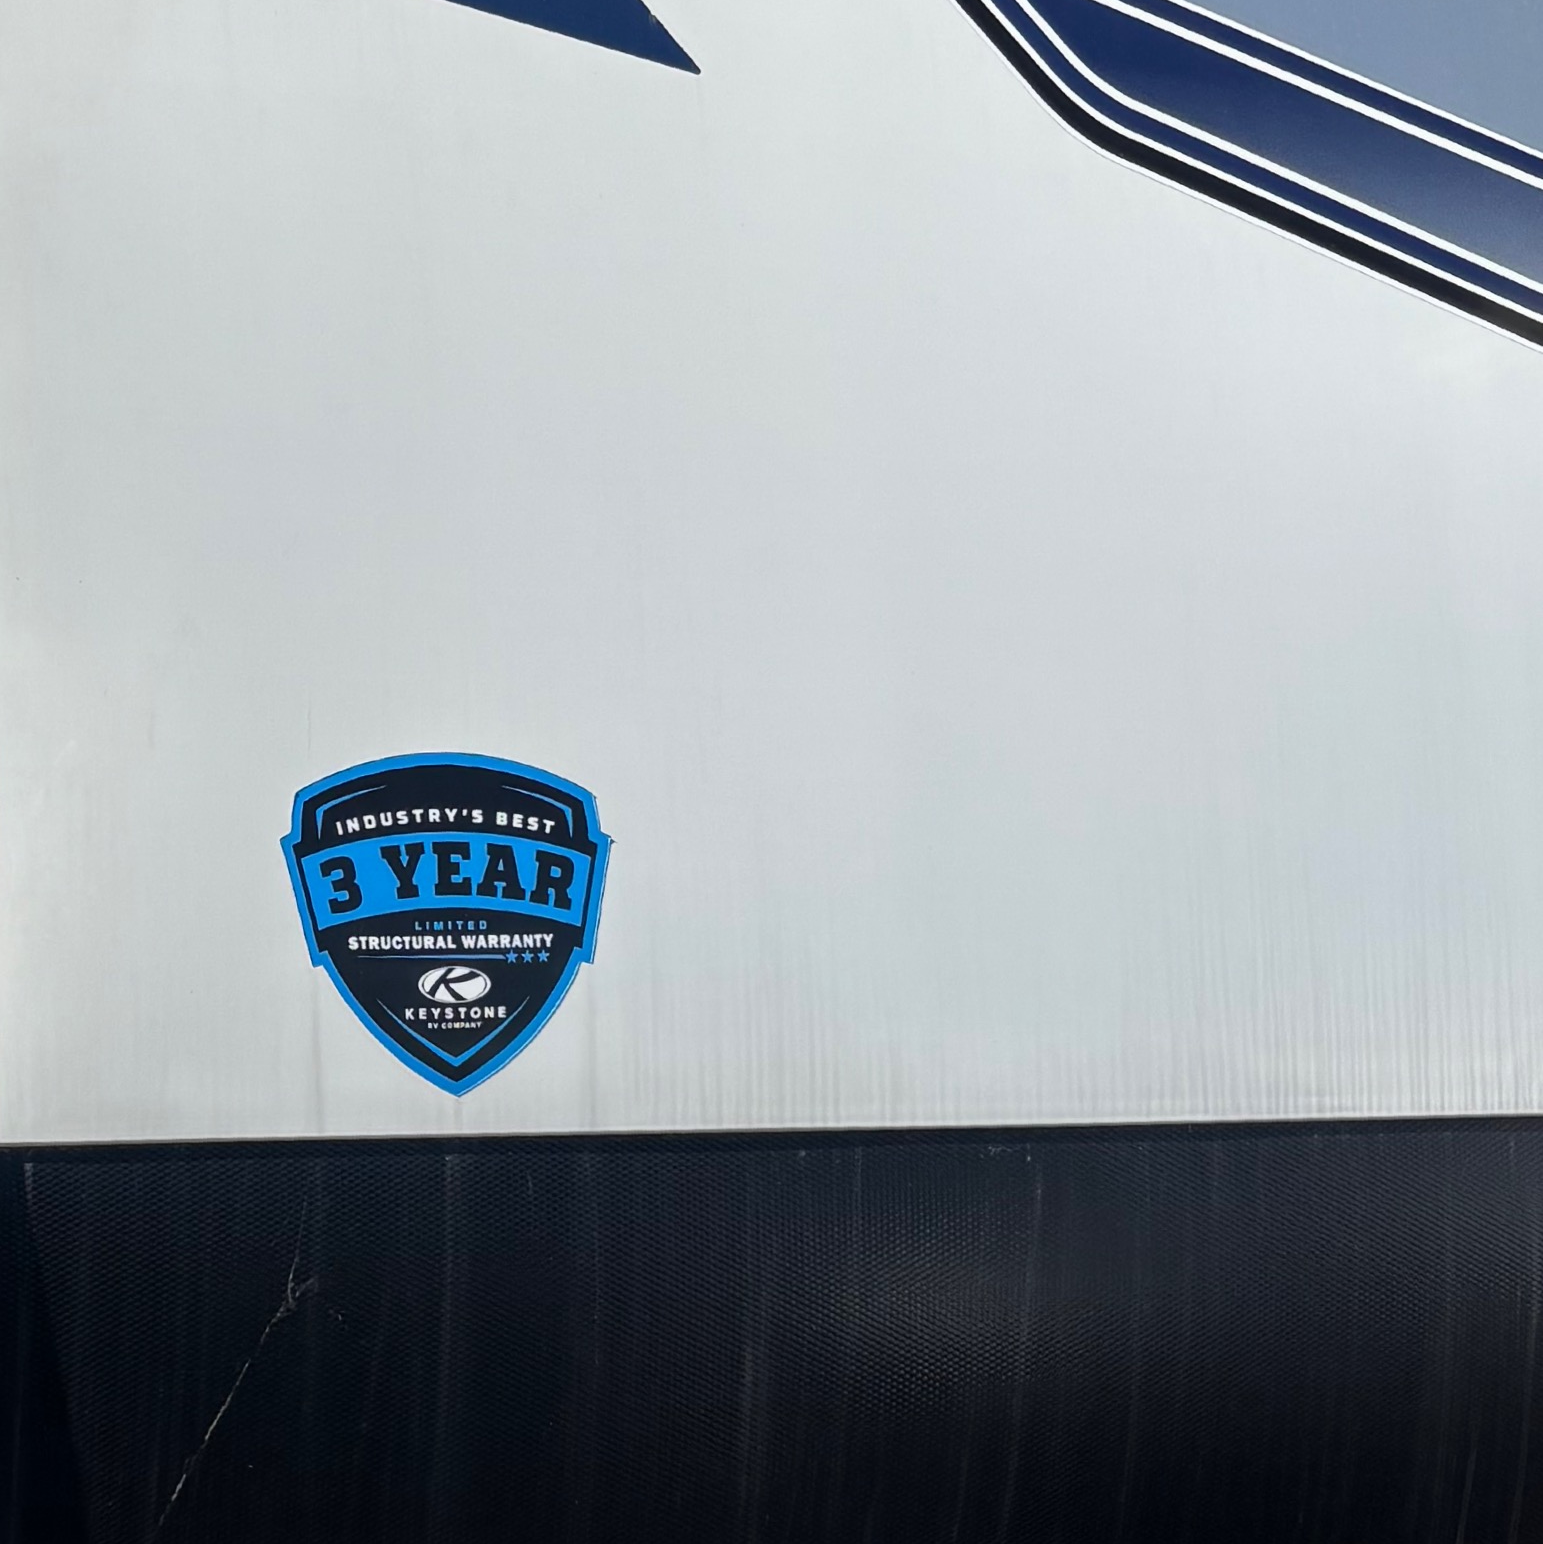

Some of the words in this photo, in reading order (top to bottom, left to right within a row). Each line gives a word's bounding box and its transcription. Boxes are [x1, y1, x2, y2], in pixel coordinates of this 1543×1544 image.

[335, 808, 485, 836] INDUSTRY'S
[495, 812, 557, 835] BEST
[319, 856, 364, 914] 3
[379, 841, 576, 911] YEAR
[414, 920, 488, 932] LIMITED
[347, 935, 457, 951] STRUCTURAL
[461, 933, 554, 949] WARRANTY
[404, 1006, 507, 1020] KEYSTONE
[441, 1021, 482, 1030] COMPANY
